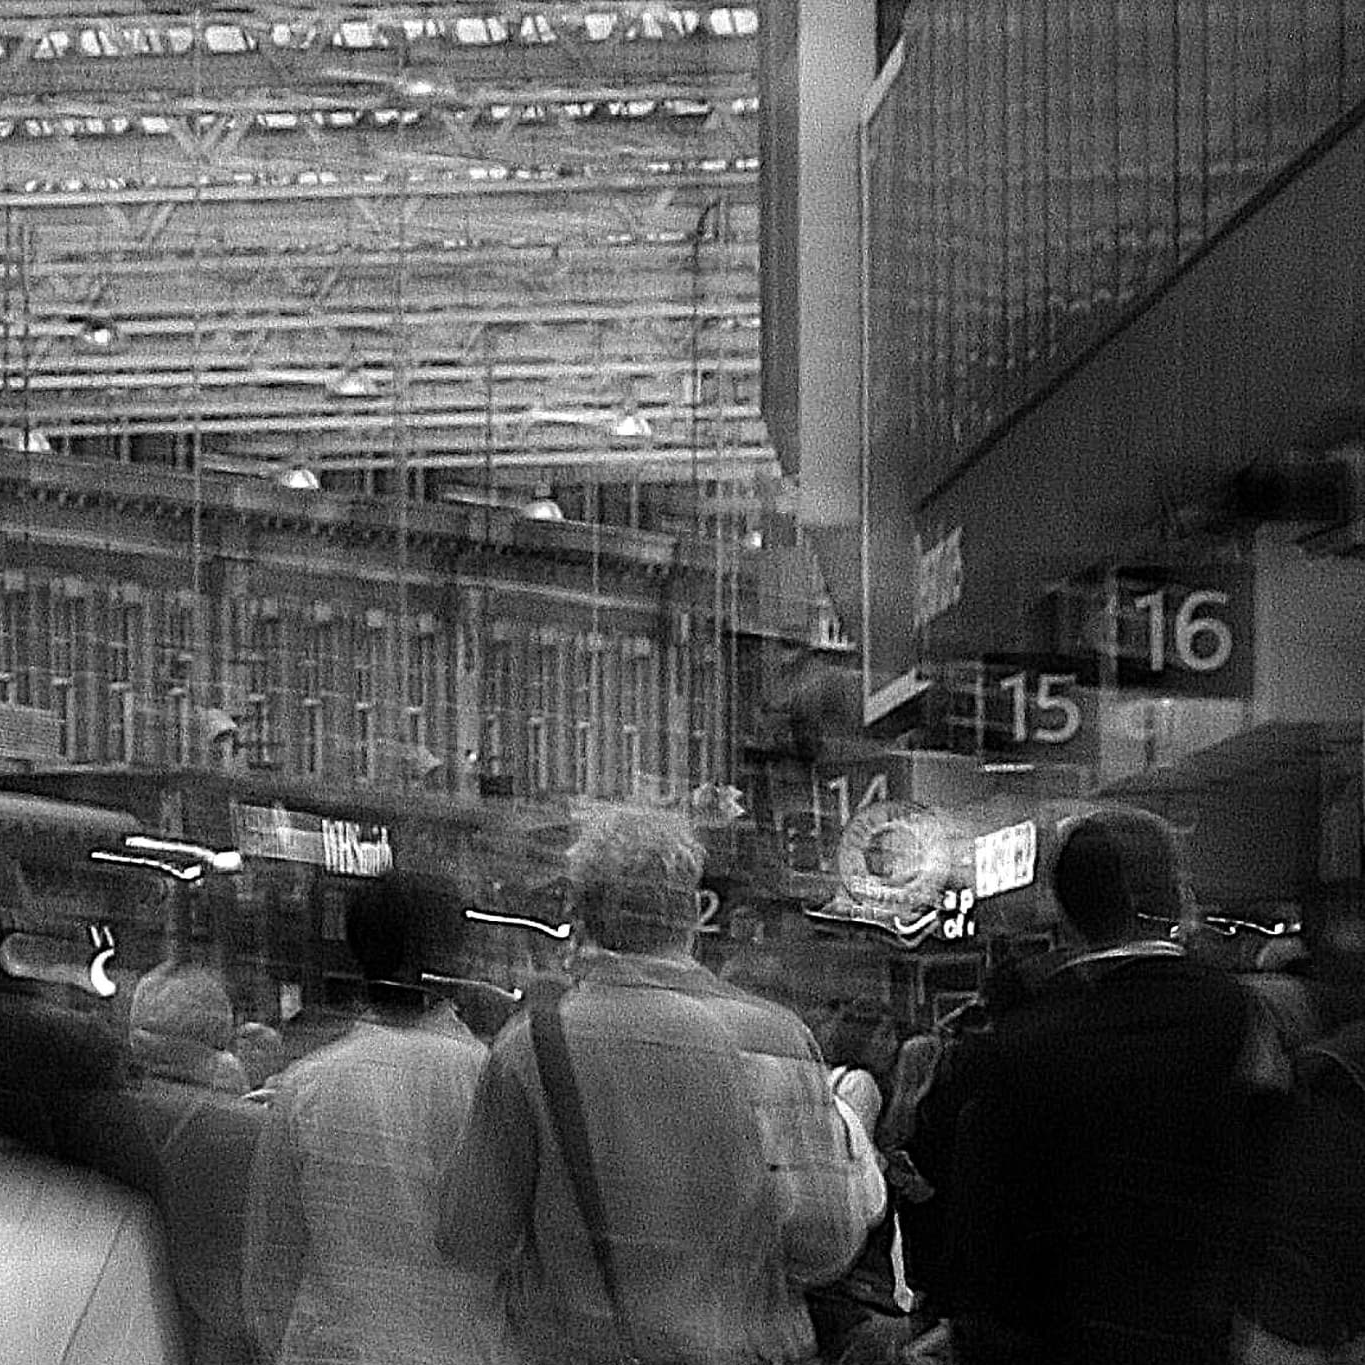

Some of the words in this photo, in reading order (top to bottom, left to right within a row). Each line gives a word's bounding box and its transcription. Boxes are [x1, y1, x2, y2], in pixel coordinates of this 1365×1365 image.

[1136, 590, 1233, 670] 16
[1000, 672, 1080, 742] 15
[828, 775, 888, 827] 14
